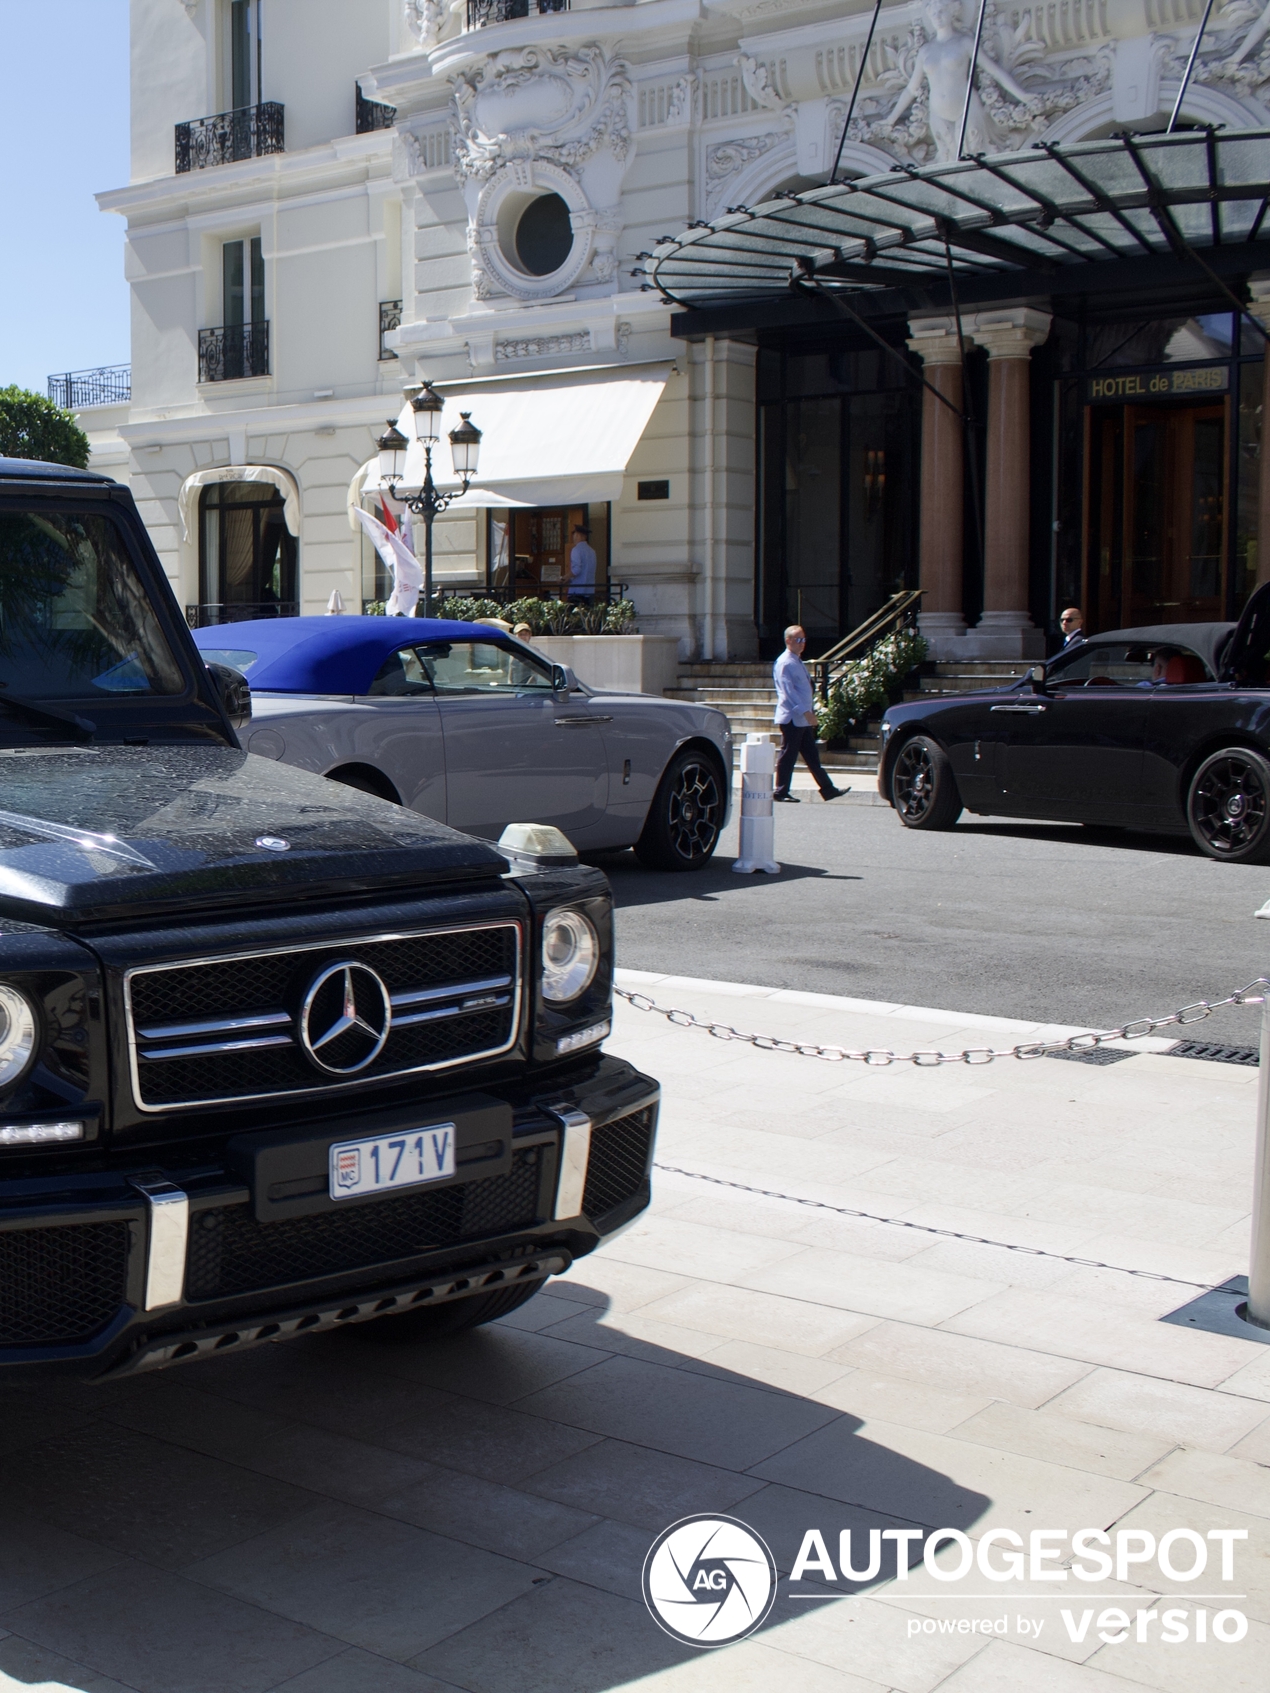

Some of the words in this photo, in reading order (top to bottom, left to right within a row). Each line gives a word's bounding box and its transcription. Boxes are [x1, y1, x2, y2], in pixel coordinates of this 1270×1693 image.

[1091, 376, 1146, 398] HOTEL
[1149, 374, 1169, 392] de
[1172, 369, 1222, 390] PARIS
[370, 1131, 449, 1184] 171V
[340, 1170, 356, 1183] MC
